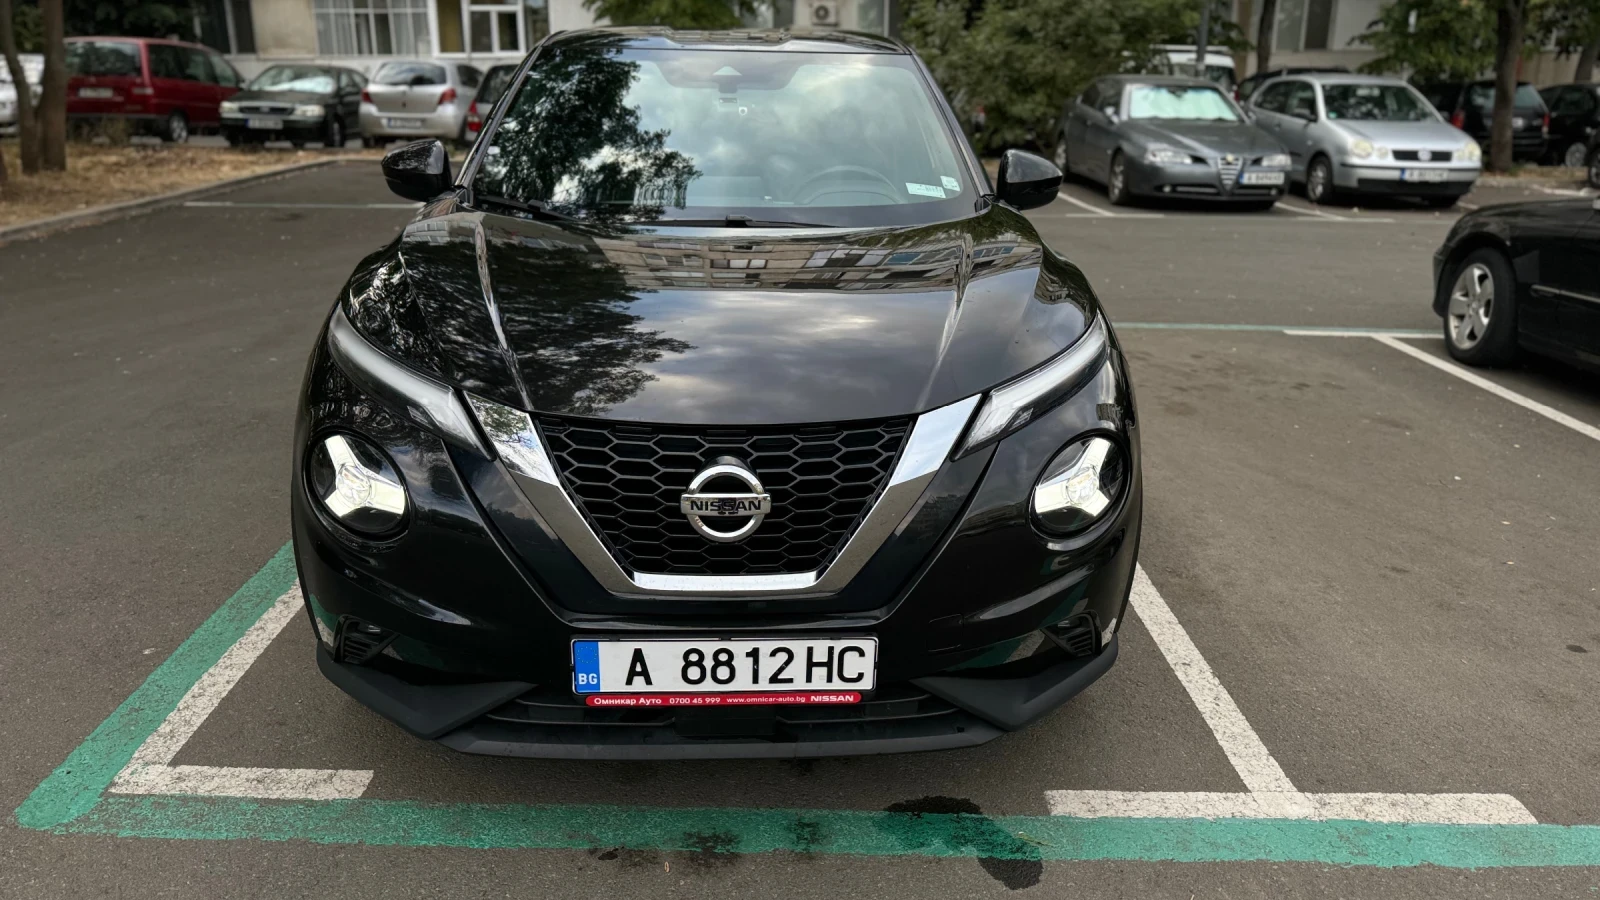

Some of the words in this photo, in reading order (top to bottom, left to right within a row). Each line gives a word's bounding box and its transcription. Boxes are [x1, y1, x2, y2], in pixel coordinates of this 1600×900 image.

[690, 500, 762, 512] NISSAN
[625, 648, 653, 685] A
[578, 673, 598, 685] BG
[594, 697, 636, 706] Омникар
[638, 697, 662, 706] Ауто
[726, 695, 805, 704] www.omnicar-auto.bg
[810, 695, 854, 703] NISSAN
